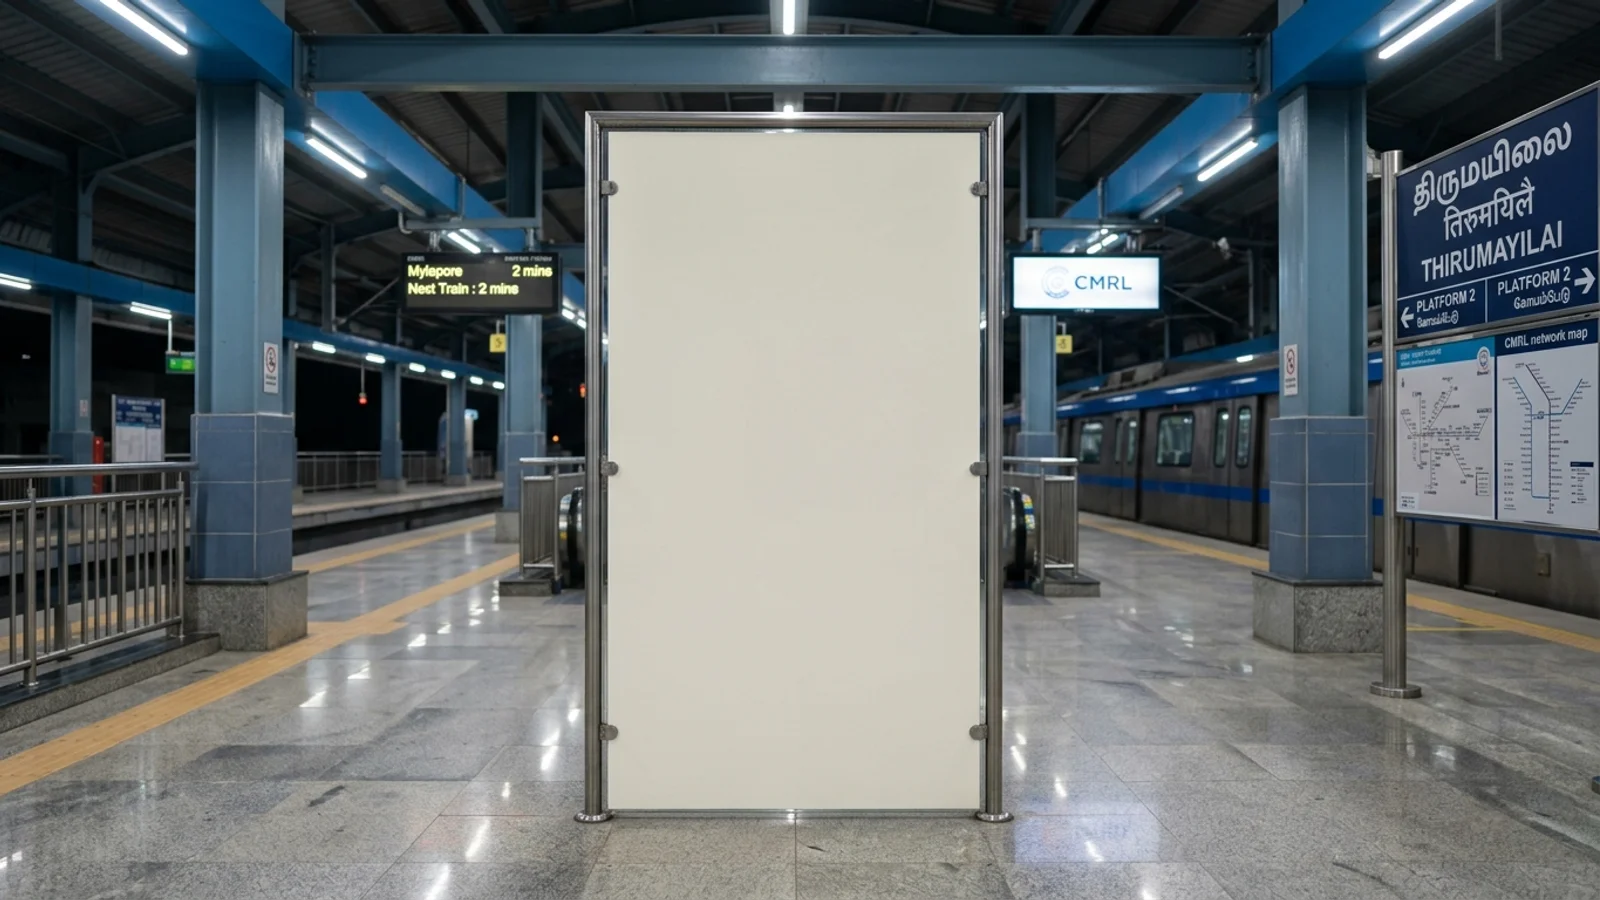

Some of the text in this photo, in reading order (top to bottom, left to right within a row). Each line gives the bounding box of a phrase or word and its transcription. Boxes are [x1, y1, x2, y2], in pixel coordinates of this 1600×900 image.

[1421, 220, 1563, 283] THIRUMAYILAI
[511, 265, 521, 277] 2
[522, 264, 553, 277] mins
[1497, 266, 1571, 296] PLATFORM 2
[438, 282, 469, 295] Train
[478, 282, 487, 295] 2
[489, 282, 519, 295] mins
[1074, 275, 1132, 291] CMRL
[1416, 288, 1476, 313] PLATFORM 2
[1504, 328, 1588, 349] CMRL network map
